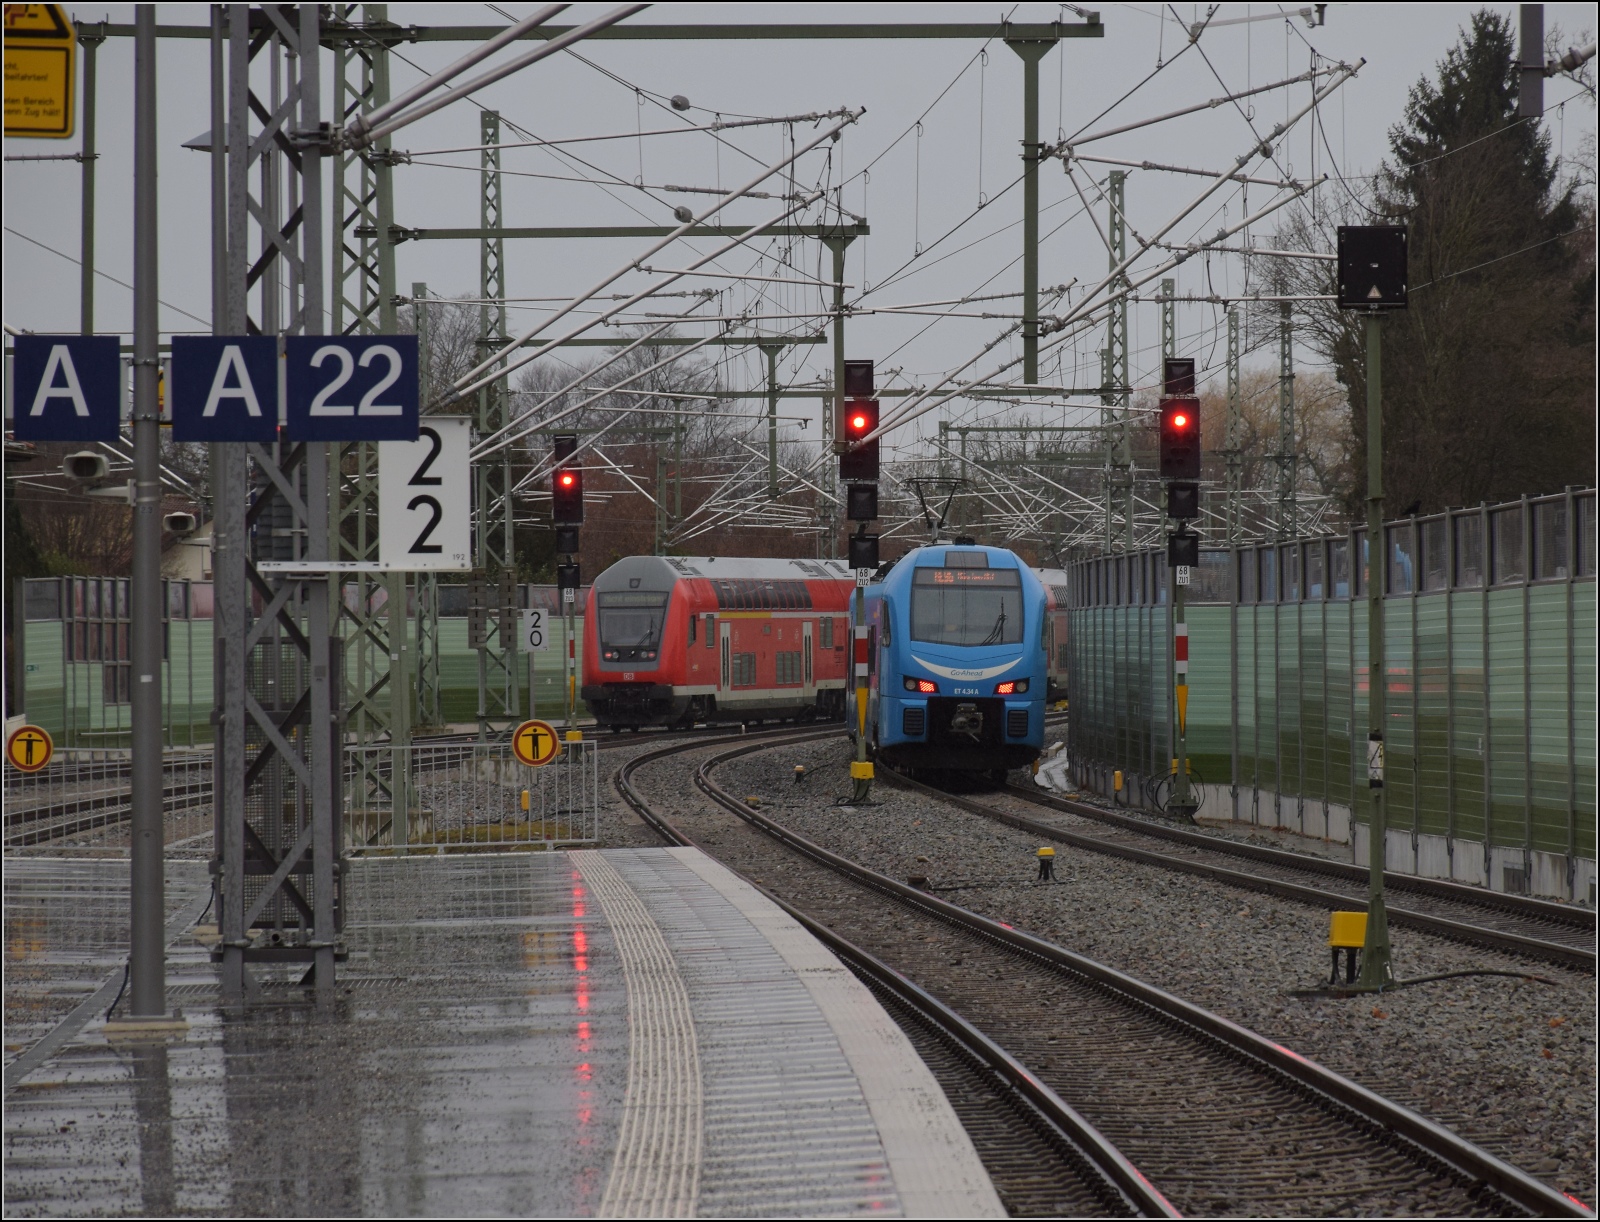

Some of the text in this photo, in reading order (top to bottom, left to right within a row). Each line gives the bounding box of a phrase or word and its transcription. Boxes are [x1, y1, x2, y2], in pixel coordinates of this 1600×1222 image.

[31, 346, 89, 415] A
[203, 346, 402, 416] A 22
[408, 427, 442, 485] 2
[407, 495, 442, 553] 2
[453, 553, 465, 561] 192
[859, 568, 868, 578] 68
[1179, 566, 1188, 575] 68
[531, 612, 541, 628] 2
[530, 630, 542, 646] 0
[624, 672, 634, 680] DB
